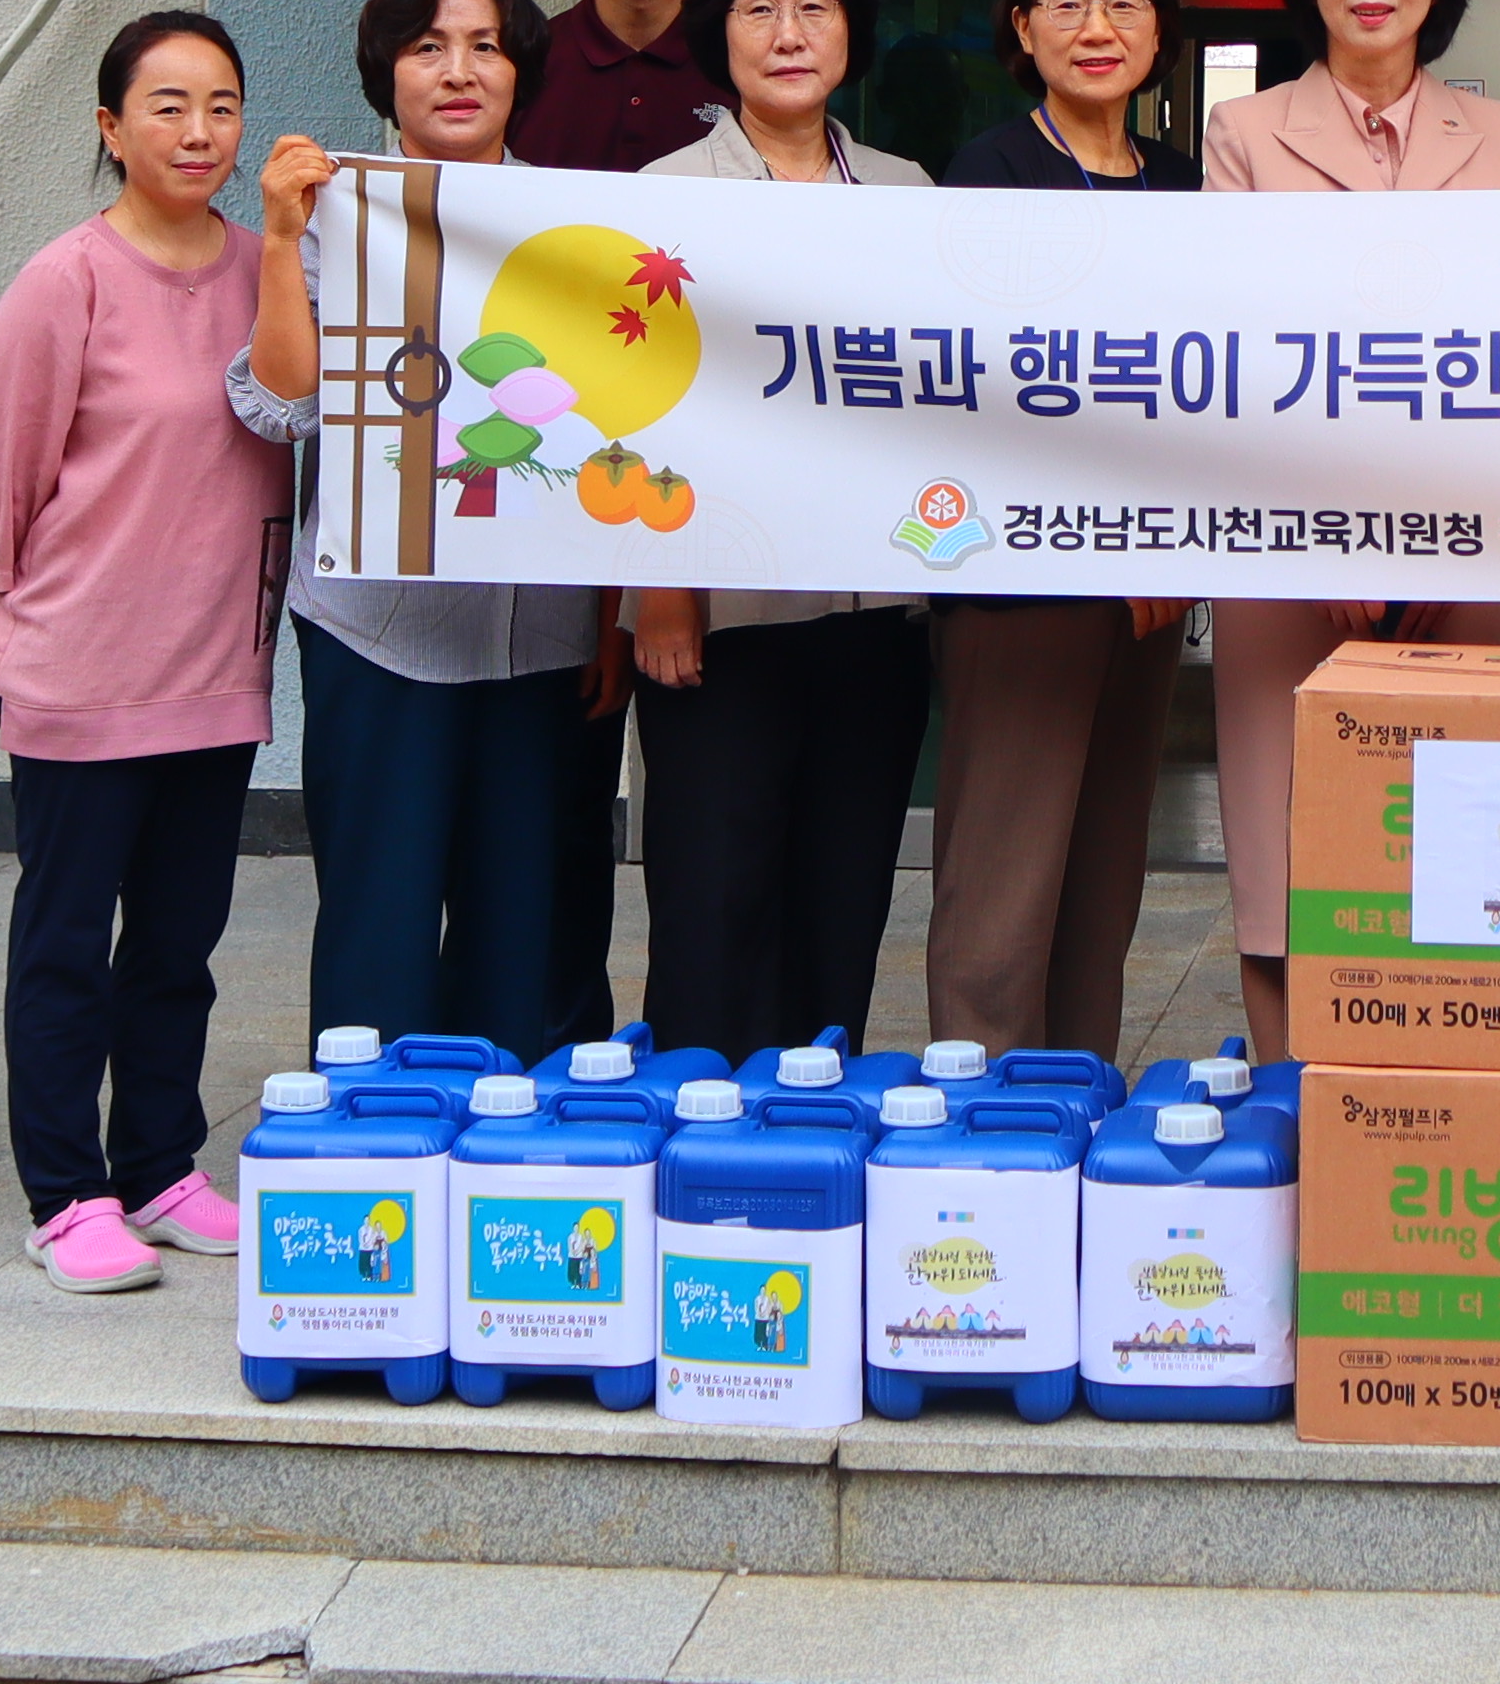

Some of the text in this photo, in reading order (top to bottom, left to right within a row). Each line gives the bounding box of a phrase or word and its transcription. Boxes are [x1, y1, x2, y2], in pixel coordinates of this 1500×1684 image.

[755, 323, 986, 413] 기쁨과
[1008, 326, 1241, 419] 행복이
[1003, 504, 1484, 557] 경상남도사천교육지원청
[1331, 998, 1407, 1027] 100매
[1415, 1007, 1432, 1026] x
[1364, 1131, 1451, 1143] www.sjpulp.com
[287, 1306, 399, 1318] 경상남도사천교육지원청
[1458, 1291, 1483, 1321] 더
[301, 1319, 385, 1331] 청렴동아리 다솜회
[496, 1313, 608, 1326] 경상남도사천교육지원청
[509, 1326, 593, 1338] 청렴동아리 다솜회
[683, 1372, 793, 1389] 경상남도사천교육지원청
[695, 1386, 779, 1401] 청렴동아리 다솜회
[1340, 1379, 1415, 1407] 100매
[1424, 1387, 1441, 1406] x
